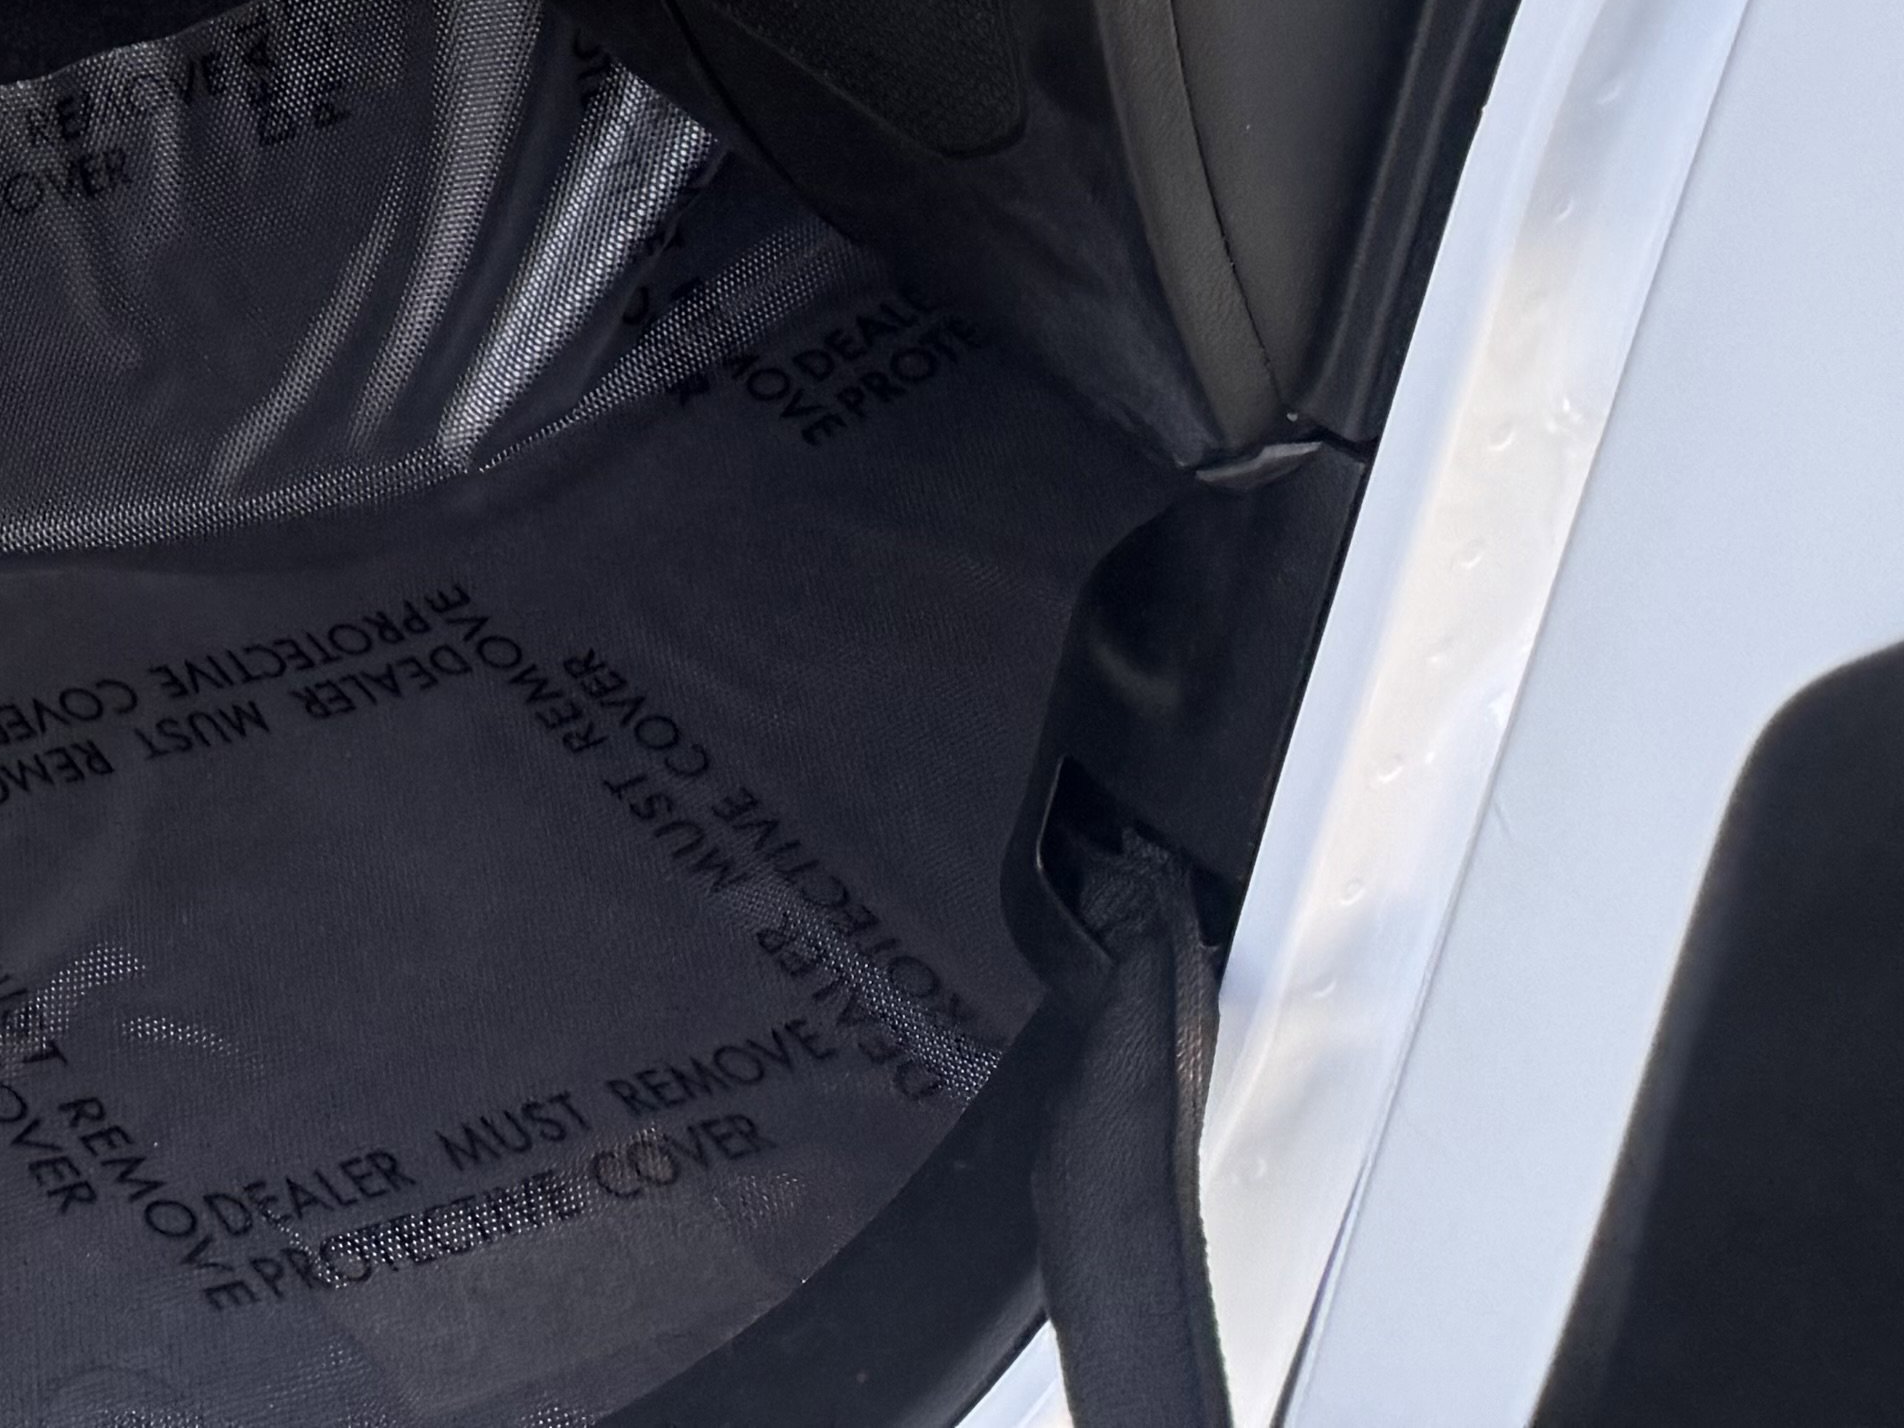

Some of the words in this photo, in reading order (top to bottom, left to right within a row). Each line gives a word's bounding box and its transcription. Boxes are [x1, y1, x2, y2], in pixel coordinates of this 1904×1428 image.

[149, 597, 433, 698] PROTECTIVE
[292, 646, 473, 723] DEALER
[427, 582, 608, 757] REMOVE
[134, 700, 271, 762] MUST
[561, 646, 714, 782] COVER
[601, 772, 750, 895] MUST
[203, 1148, 417, 1240] DEALER
[434, 1091, 593, 1172] MUST
[605, 1016, 838, 1118] REMOVE
[590, 1111, 779, 1200] COVER
[57, 1095, 261, 1313] REMOVE
